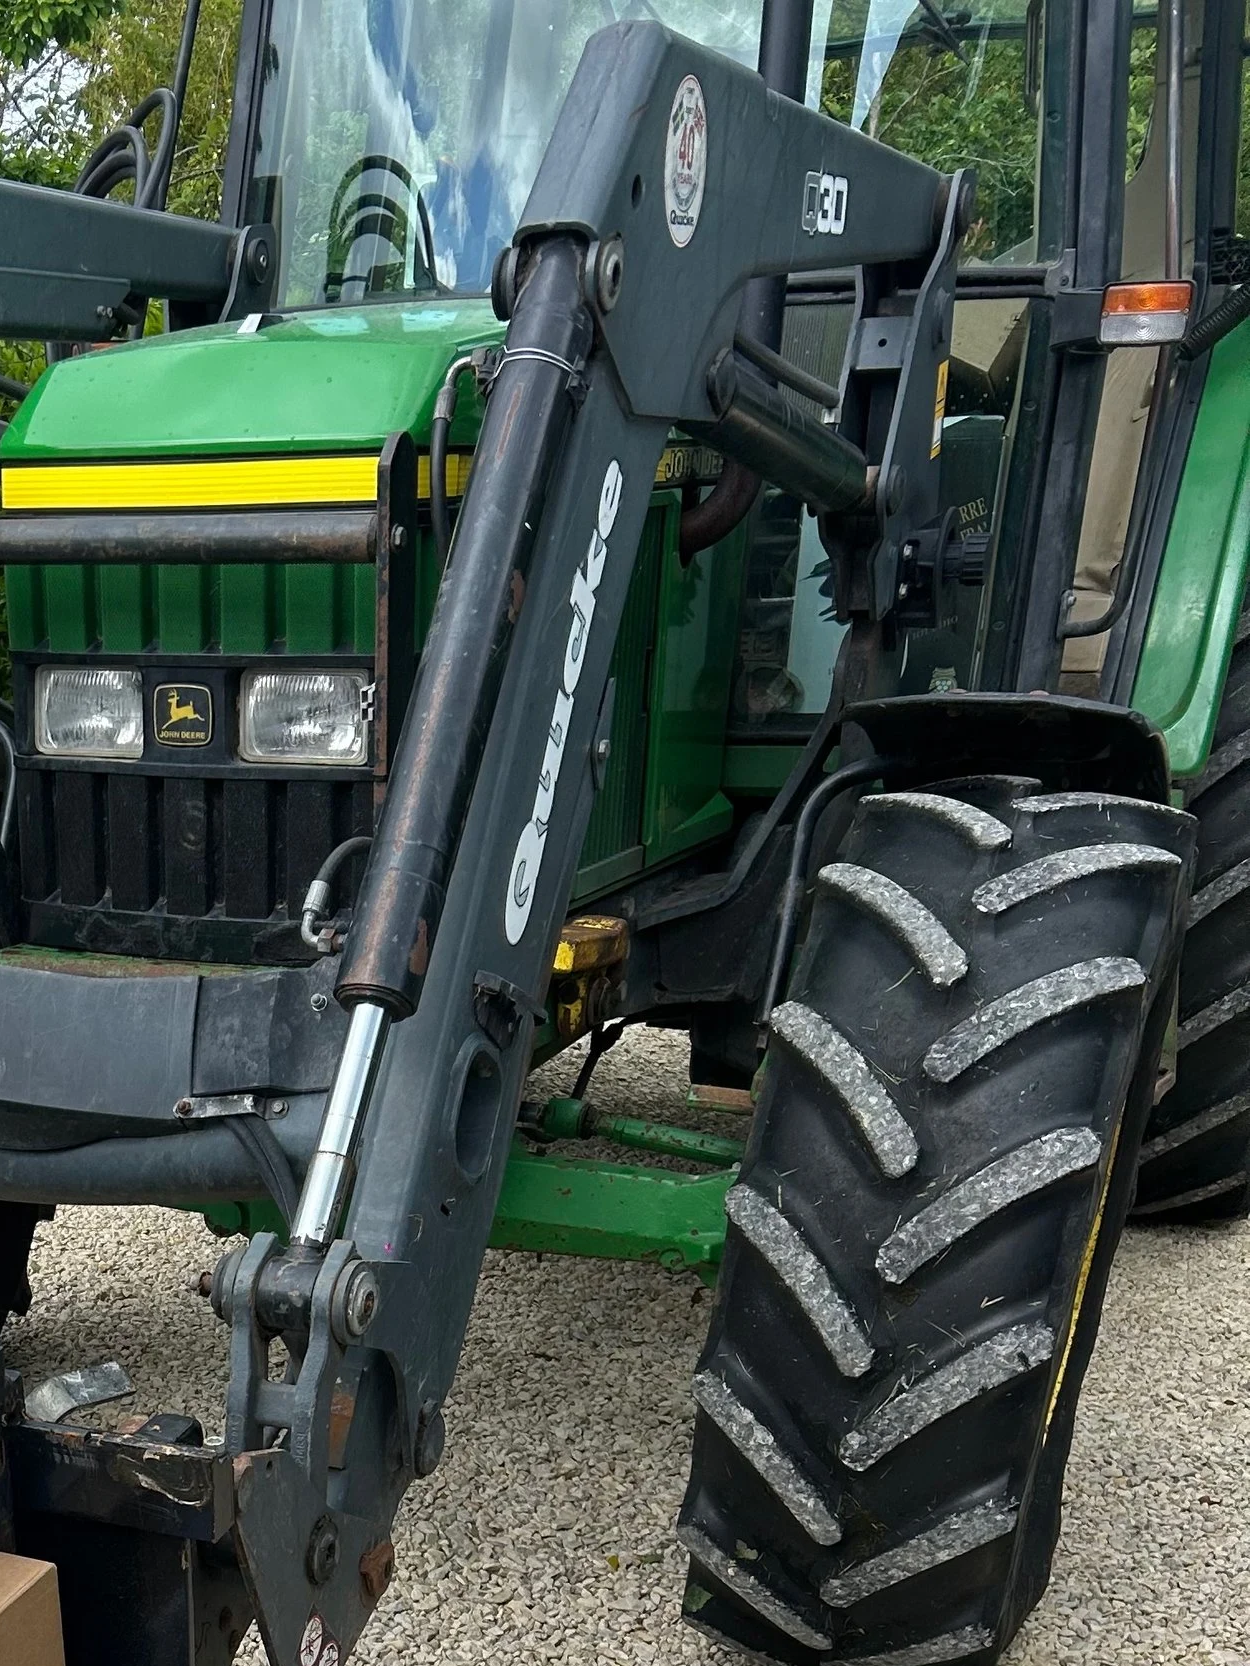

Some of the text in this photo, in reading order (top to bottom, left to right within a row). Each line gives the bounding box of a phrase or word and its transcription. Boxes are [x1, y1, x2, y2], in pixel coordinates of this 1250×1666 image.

[678, 124, 695, 171] 40
[802, 170, 849, 236] Q30
[956, 498, 988, 525] RRE
[160, 730, 205, 740] JOHN DEERE
